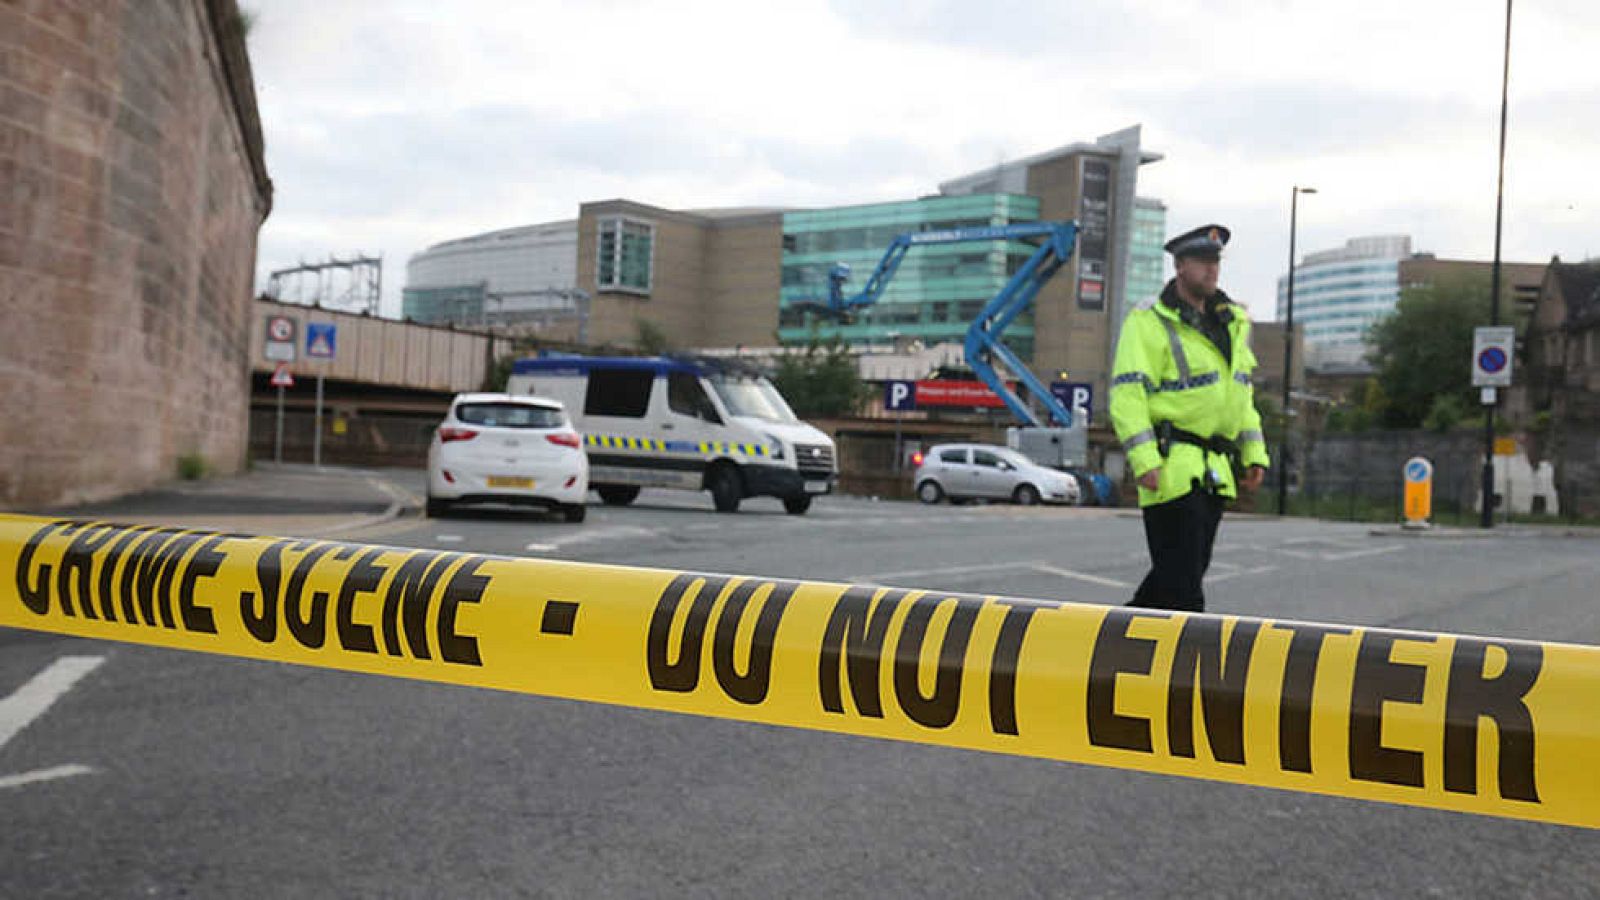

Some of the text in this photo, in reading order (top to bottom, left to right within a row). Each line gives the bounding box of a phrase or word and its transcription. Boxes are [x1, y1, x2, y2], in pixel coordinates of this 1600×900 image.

[892, 383, 908, 408] P
[16, 520, 248, 634] CRIME
[240, 537, 503, 666] SCENE
[647, 574, 800, 705] DO
[818, 586, 1058, 735] NOT
[1086, 609, 1543, 804] ENTER
